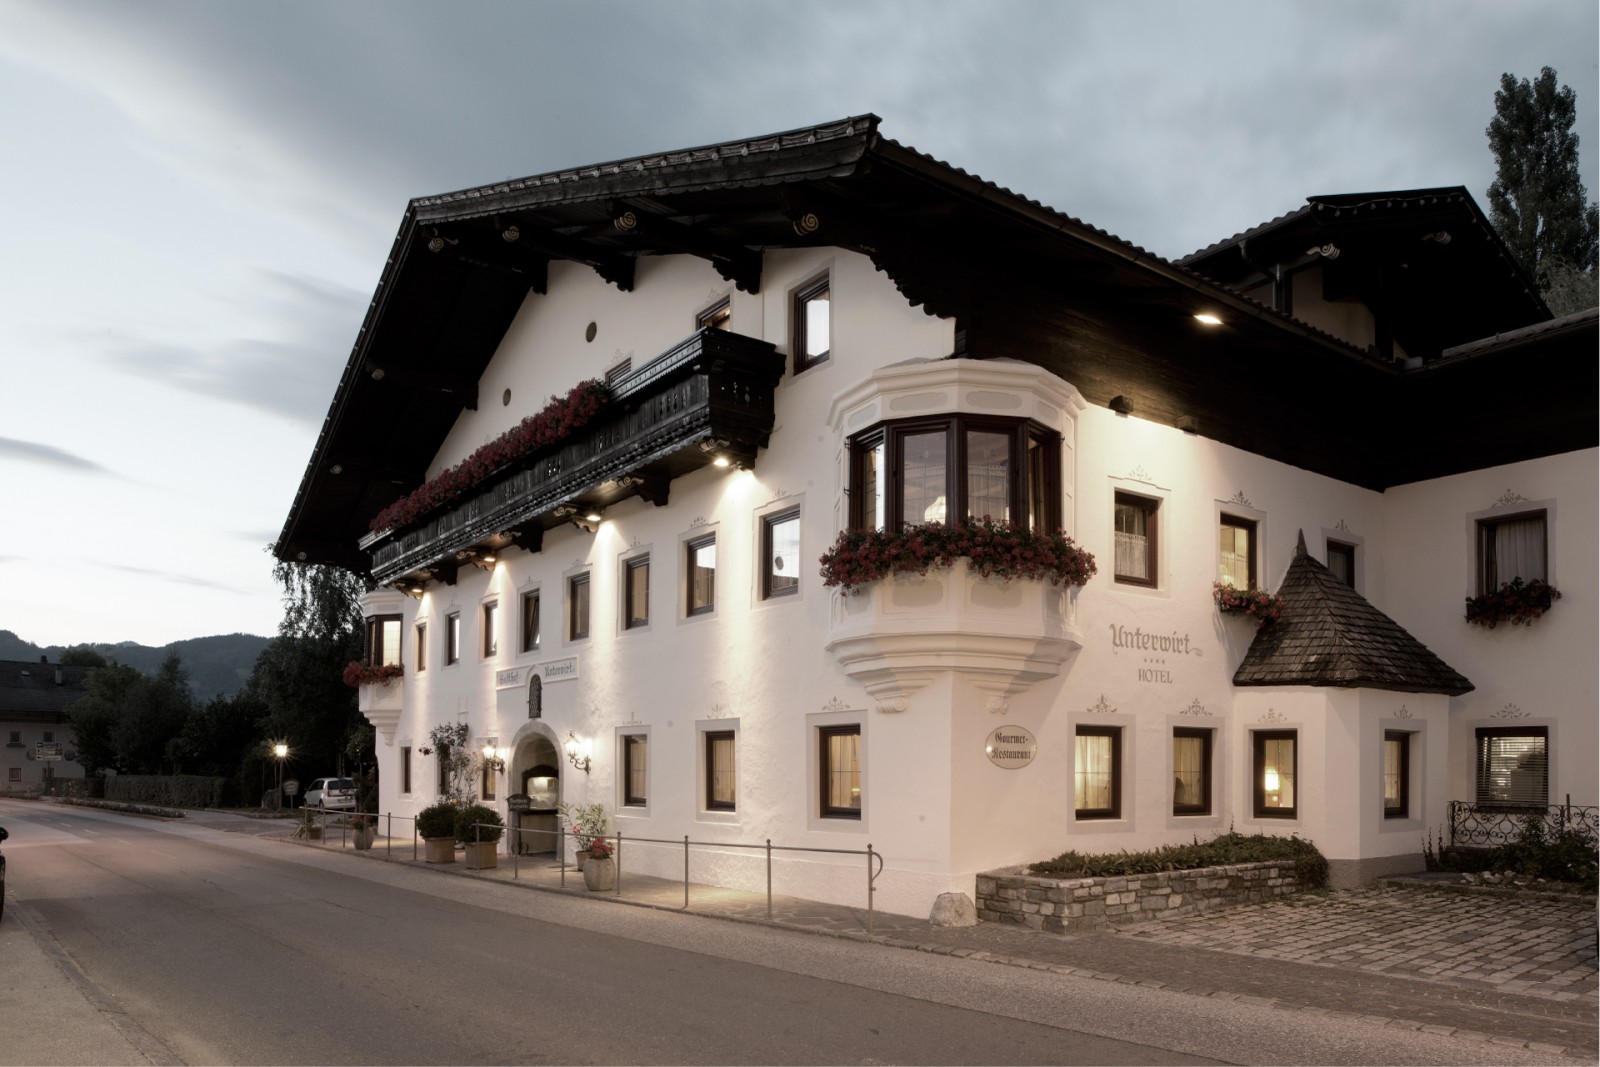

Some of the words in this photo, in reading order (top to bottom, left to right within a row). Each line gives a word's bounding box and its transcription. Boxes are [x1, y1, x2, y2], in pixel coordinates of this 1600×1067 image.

[1109, 623, 1202, 656] Unterwirt
[1138, 669, 1173, 684] HOTEL
[992, 746, 1031, 759] Restaurant
